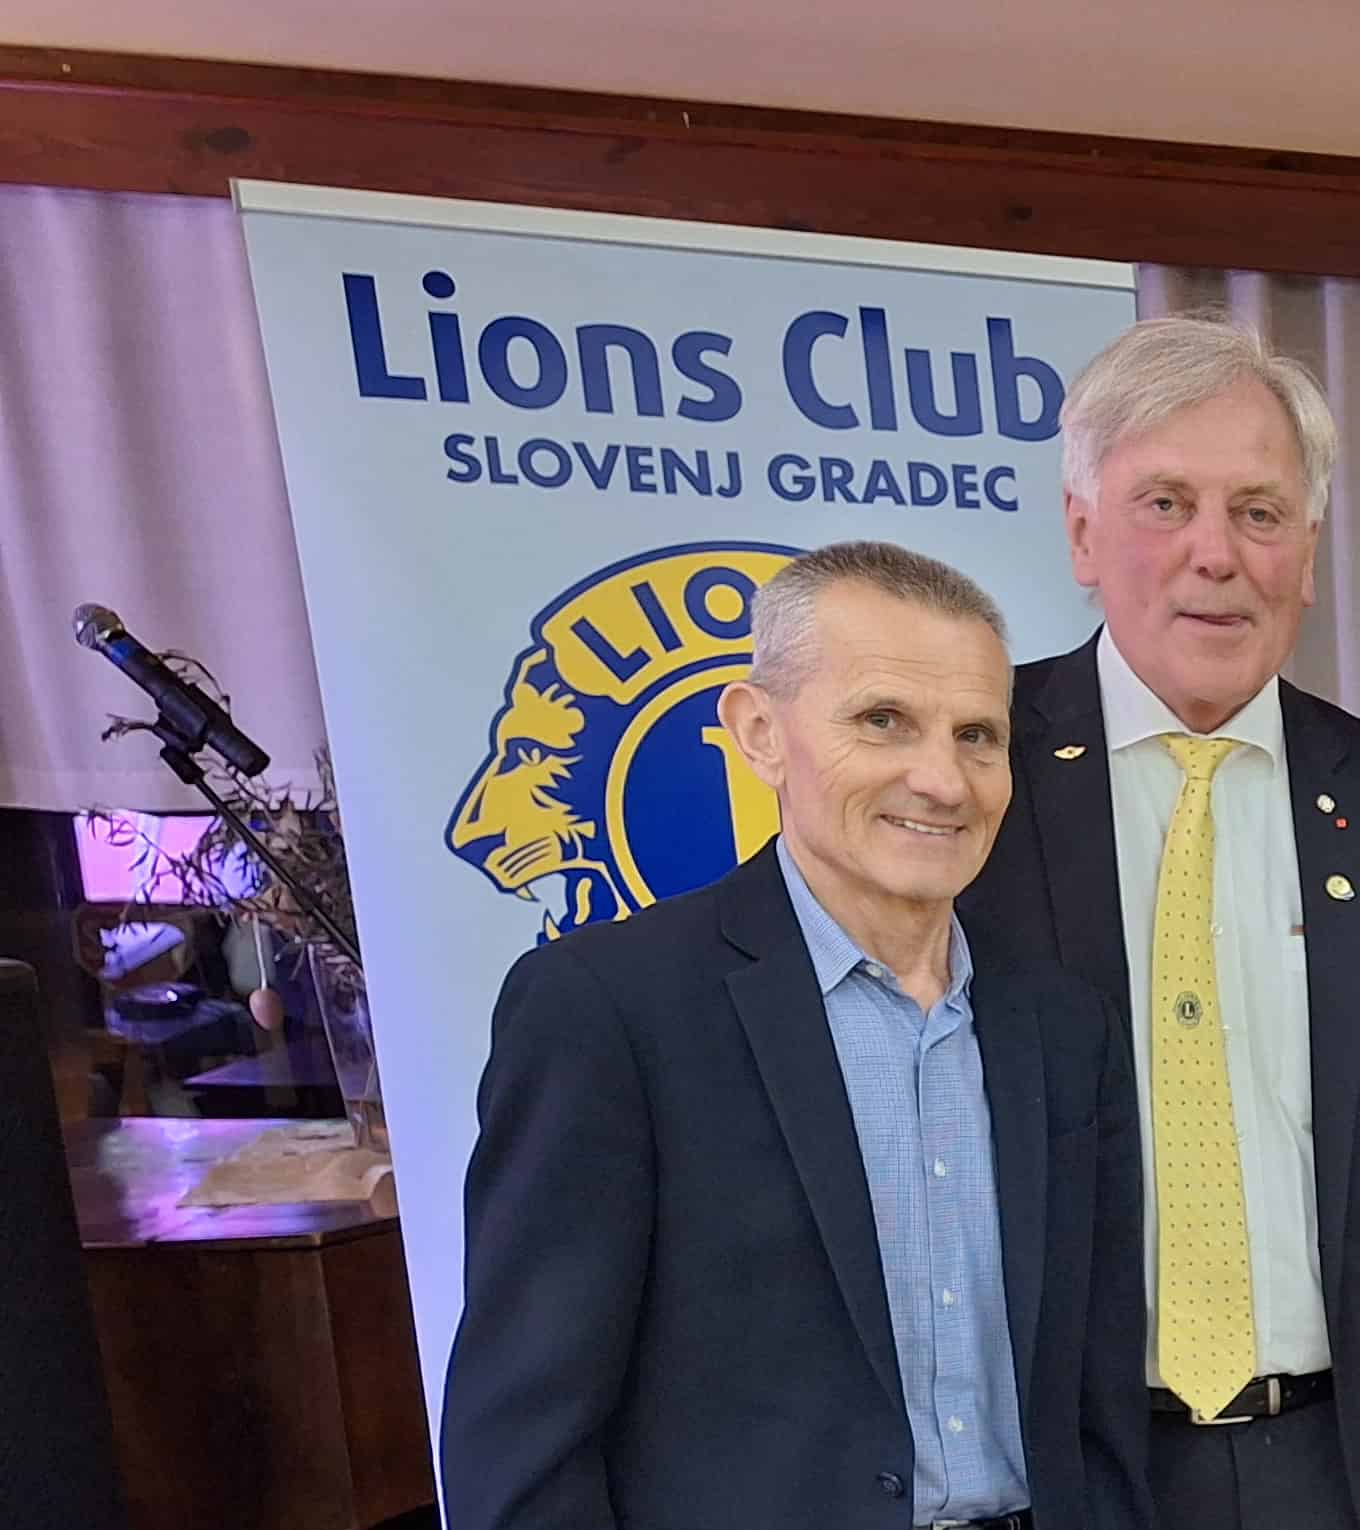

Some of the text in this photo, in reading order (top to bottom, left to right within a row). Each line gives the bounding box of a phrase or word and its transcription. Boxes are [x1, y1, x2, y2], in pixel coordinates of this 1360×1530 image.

[342, 269, 1066, 442] Lions Club
[443, 432, 1019, 512] SLOVENJ GRADEC
[569, 565, 759, 684] LIO
